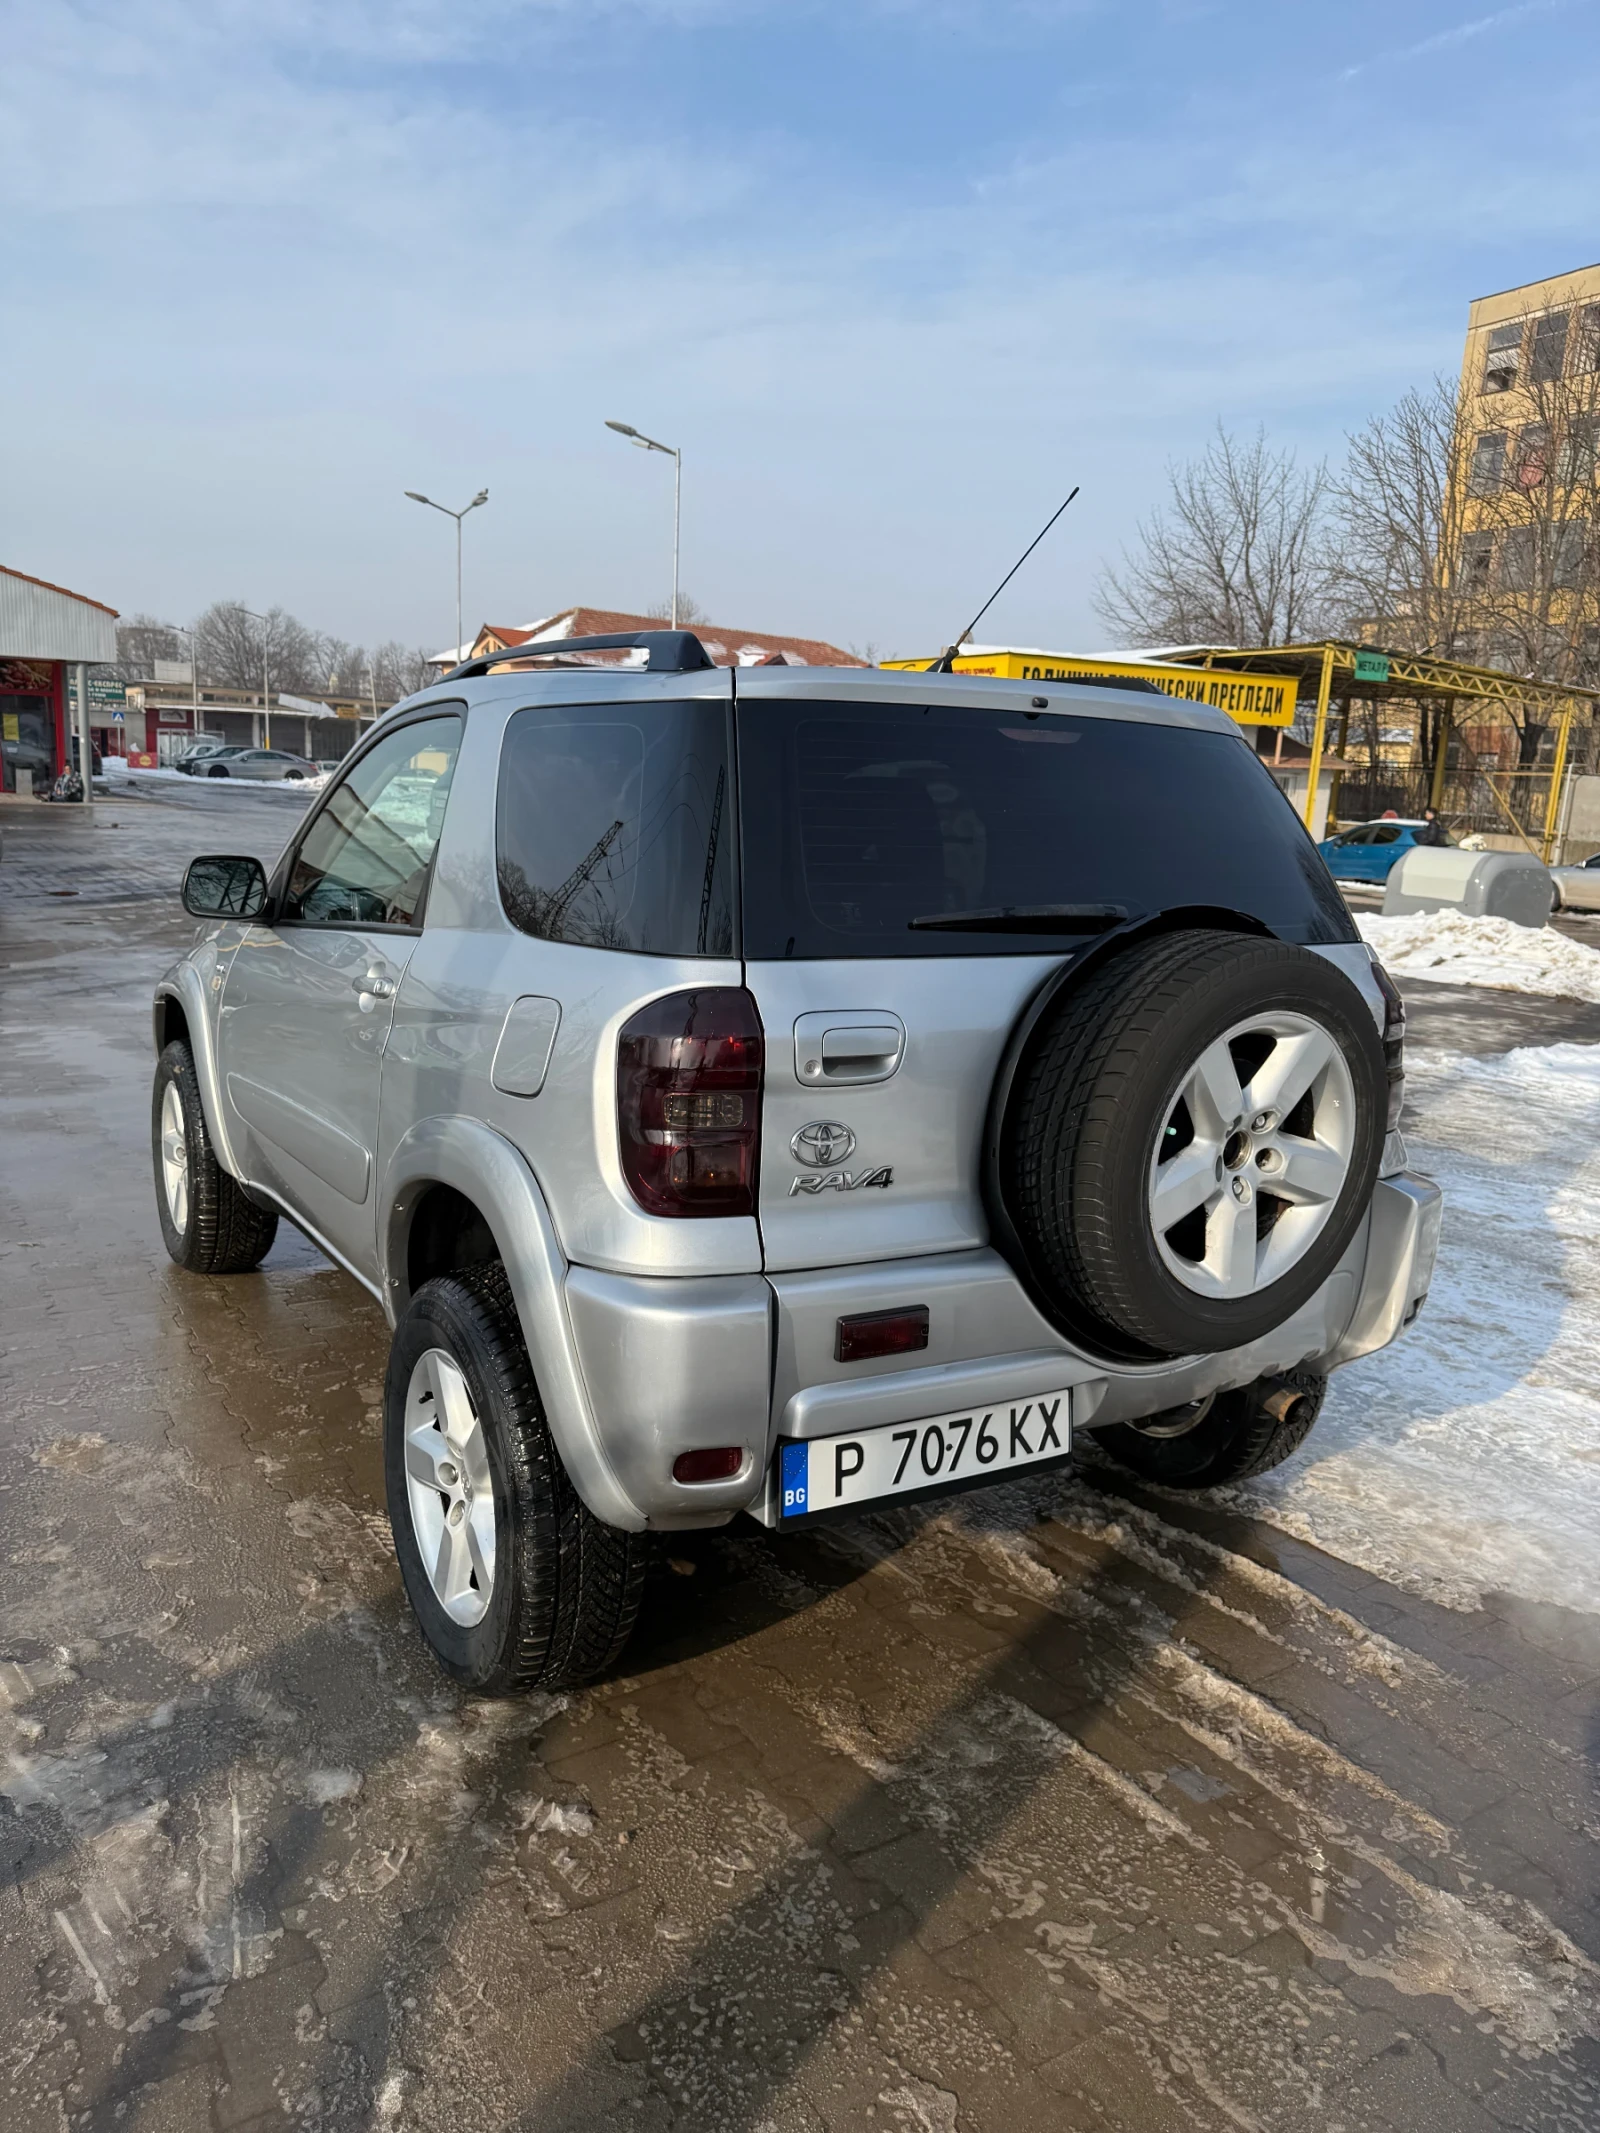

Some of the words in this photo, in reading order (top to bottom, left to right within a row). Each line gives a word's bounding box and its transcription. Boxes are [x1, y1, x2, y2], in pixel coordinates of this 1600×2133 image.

[1209, 681, 1285, 717] ПРЕГЛЕДИ
[788, 1165, 893, 1197] RAV4
[835, 1442, 864, 1498] P
[891, 1413, 999, 1485] 7076
[1009, 1398, 1062, 1459] KX
[784, 1488, 806, 1507] BG
